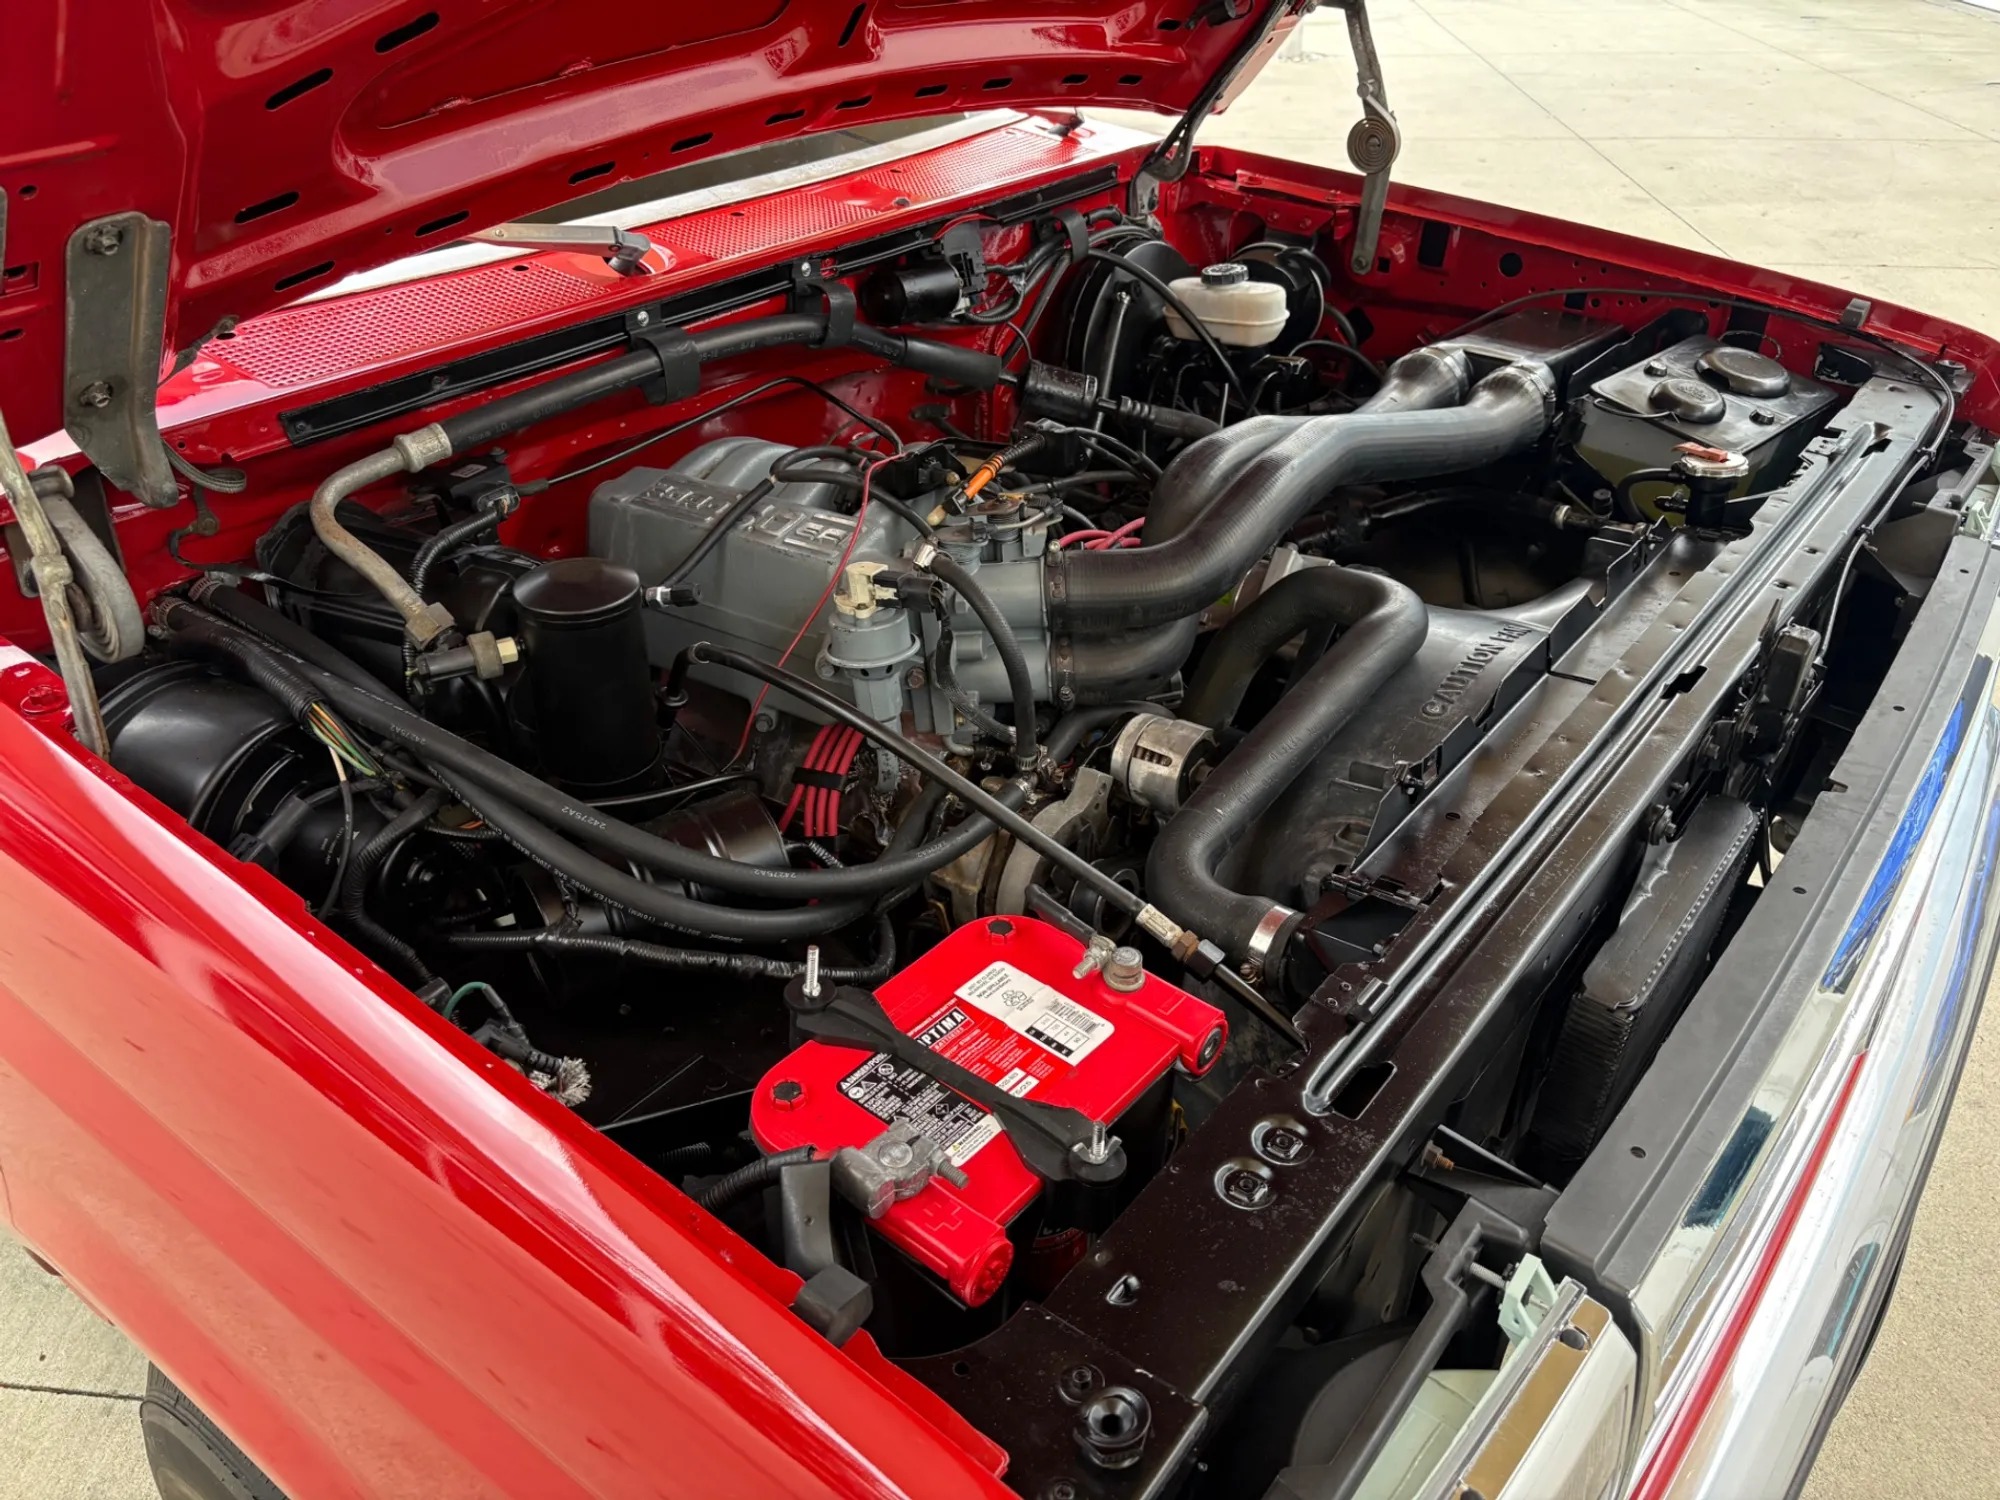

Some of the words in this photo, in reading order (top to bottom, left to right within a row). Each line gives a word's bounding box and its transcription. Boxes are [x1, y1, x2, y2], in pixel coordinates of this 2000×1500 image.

[1421, 643, 1505, 719] CAUTION
[560, 805, 606, 829] 24275A2
[511, 840, 531, 854] MADE
[753, 868, 796, 879] 24275A2
[570, 880, 591, 891] HOSE
[592, 891, 624, 908] HEATER
[957, 1123, 983, 1146] WARNING:
